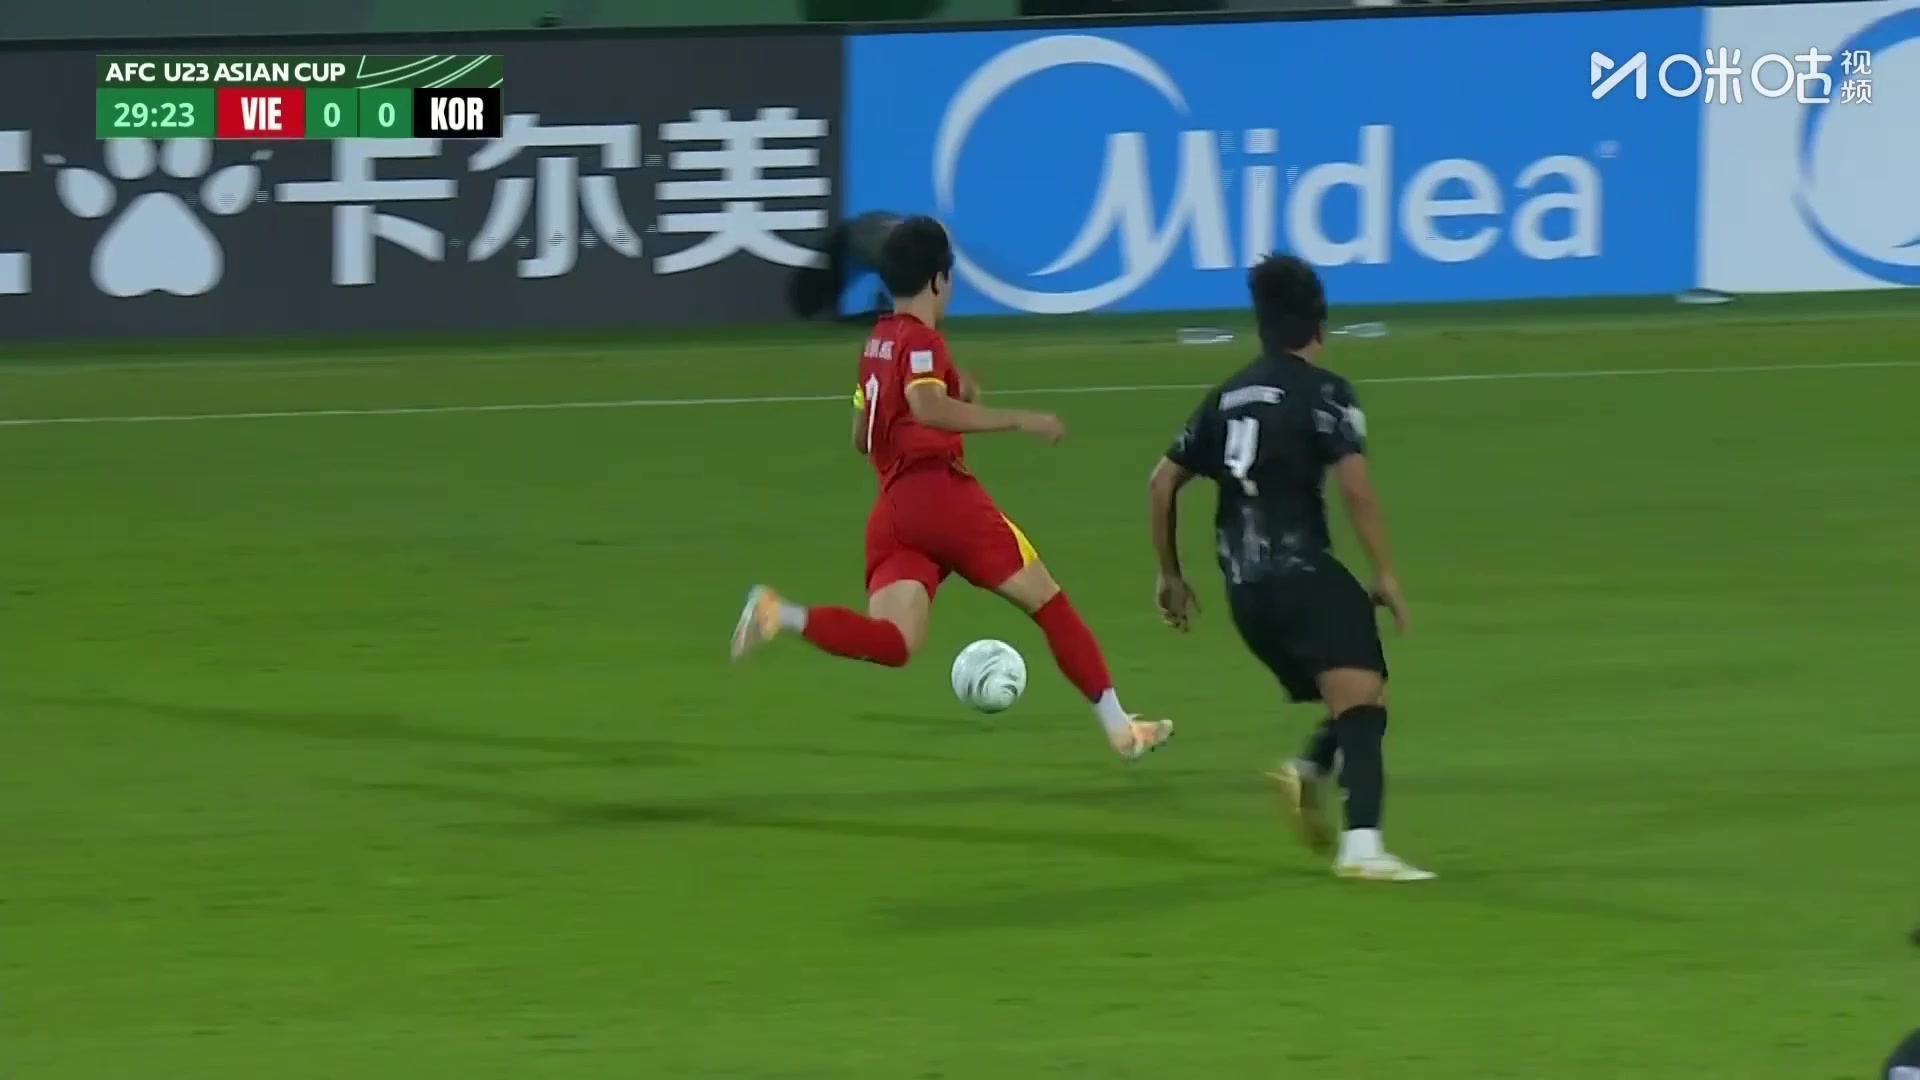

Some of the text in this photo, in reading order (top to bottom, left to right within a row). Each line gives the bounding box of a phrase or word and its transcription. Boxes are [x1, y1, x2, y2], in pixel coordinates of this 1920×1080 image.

[275, 105, 834, 286] 卡尔美
[1027, 124, 1601, 277] Midea
